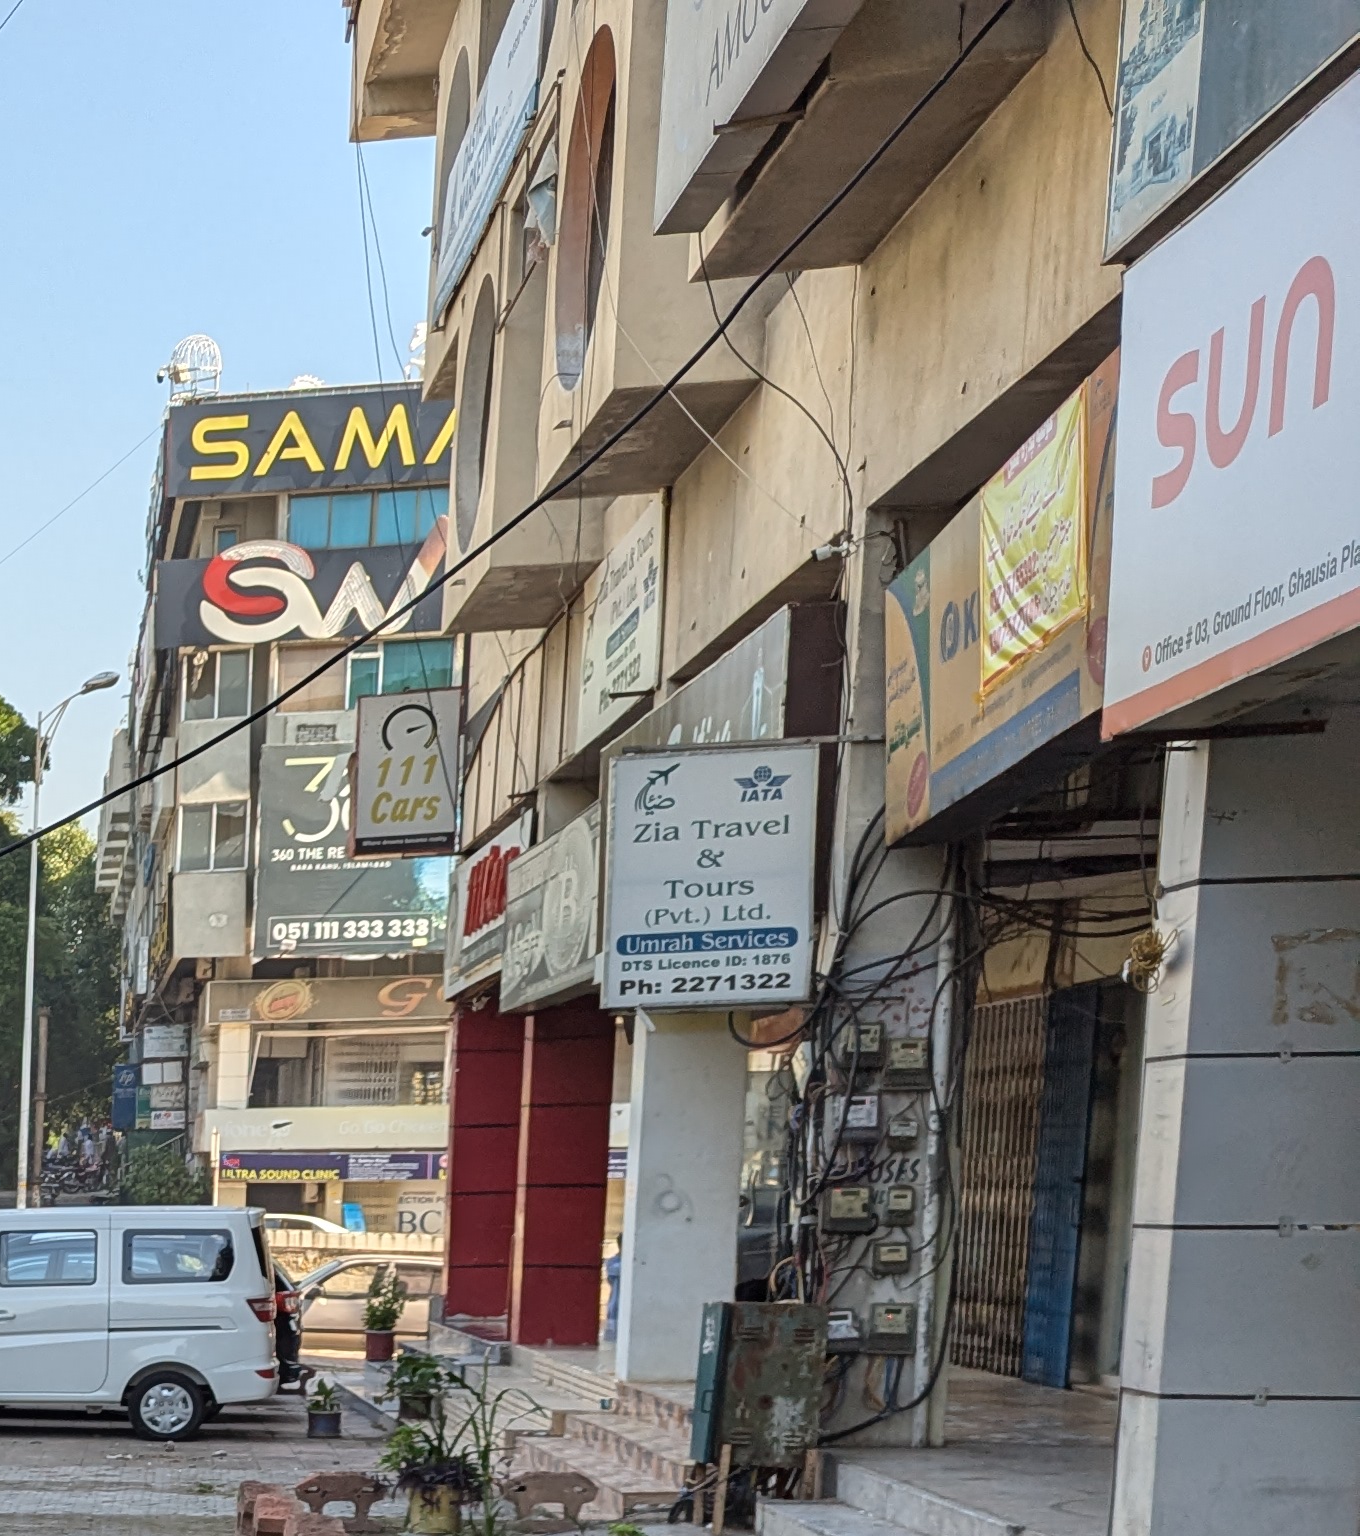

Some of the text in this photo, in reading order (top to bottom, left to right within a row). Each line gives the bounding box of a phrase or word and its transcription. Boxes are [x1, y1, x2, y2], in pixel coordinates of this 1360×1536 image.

[1154, 634, 1184, 666] Office
[1185, 625, 1193, 650] #
[1194, 618, 1210, 645] 03,
[1213, 593, 1253, 636] Ground
[1253, 583, 1285, 617] Floor,
[1288, 552, 1338, 598] Ghausia
[740, 788, 784, 803] IATA
[370, 791, 442, 825] Cars
[632, 814, 791, 844] Zia Travel
[269, 846, 346, 862] 360 THE RE
[696, 848, 725, 869] &
[663, 877, 755, 899] Tours
[644, 903, 772, 929] (Pvt.) Ltd.
[272, 921, 309, 941] 051
[314, 920, 340, 940] 111
[343, 919, 384, 939] 333
[625, 929, 790, 954] Umrah Services
[620, 953, 791, 972] DTS Licence ID: 1876
[619, 972, 791, 997] Ph: 2271322
[259, 1168, 301, 1180] SOUND
[301, 1168, 340, 1181] CLINIC
